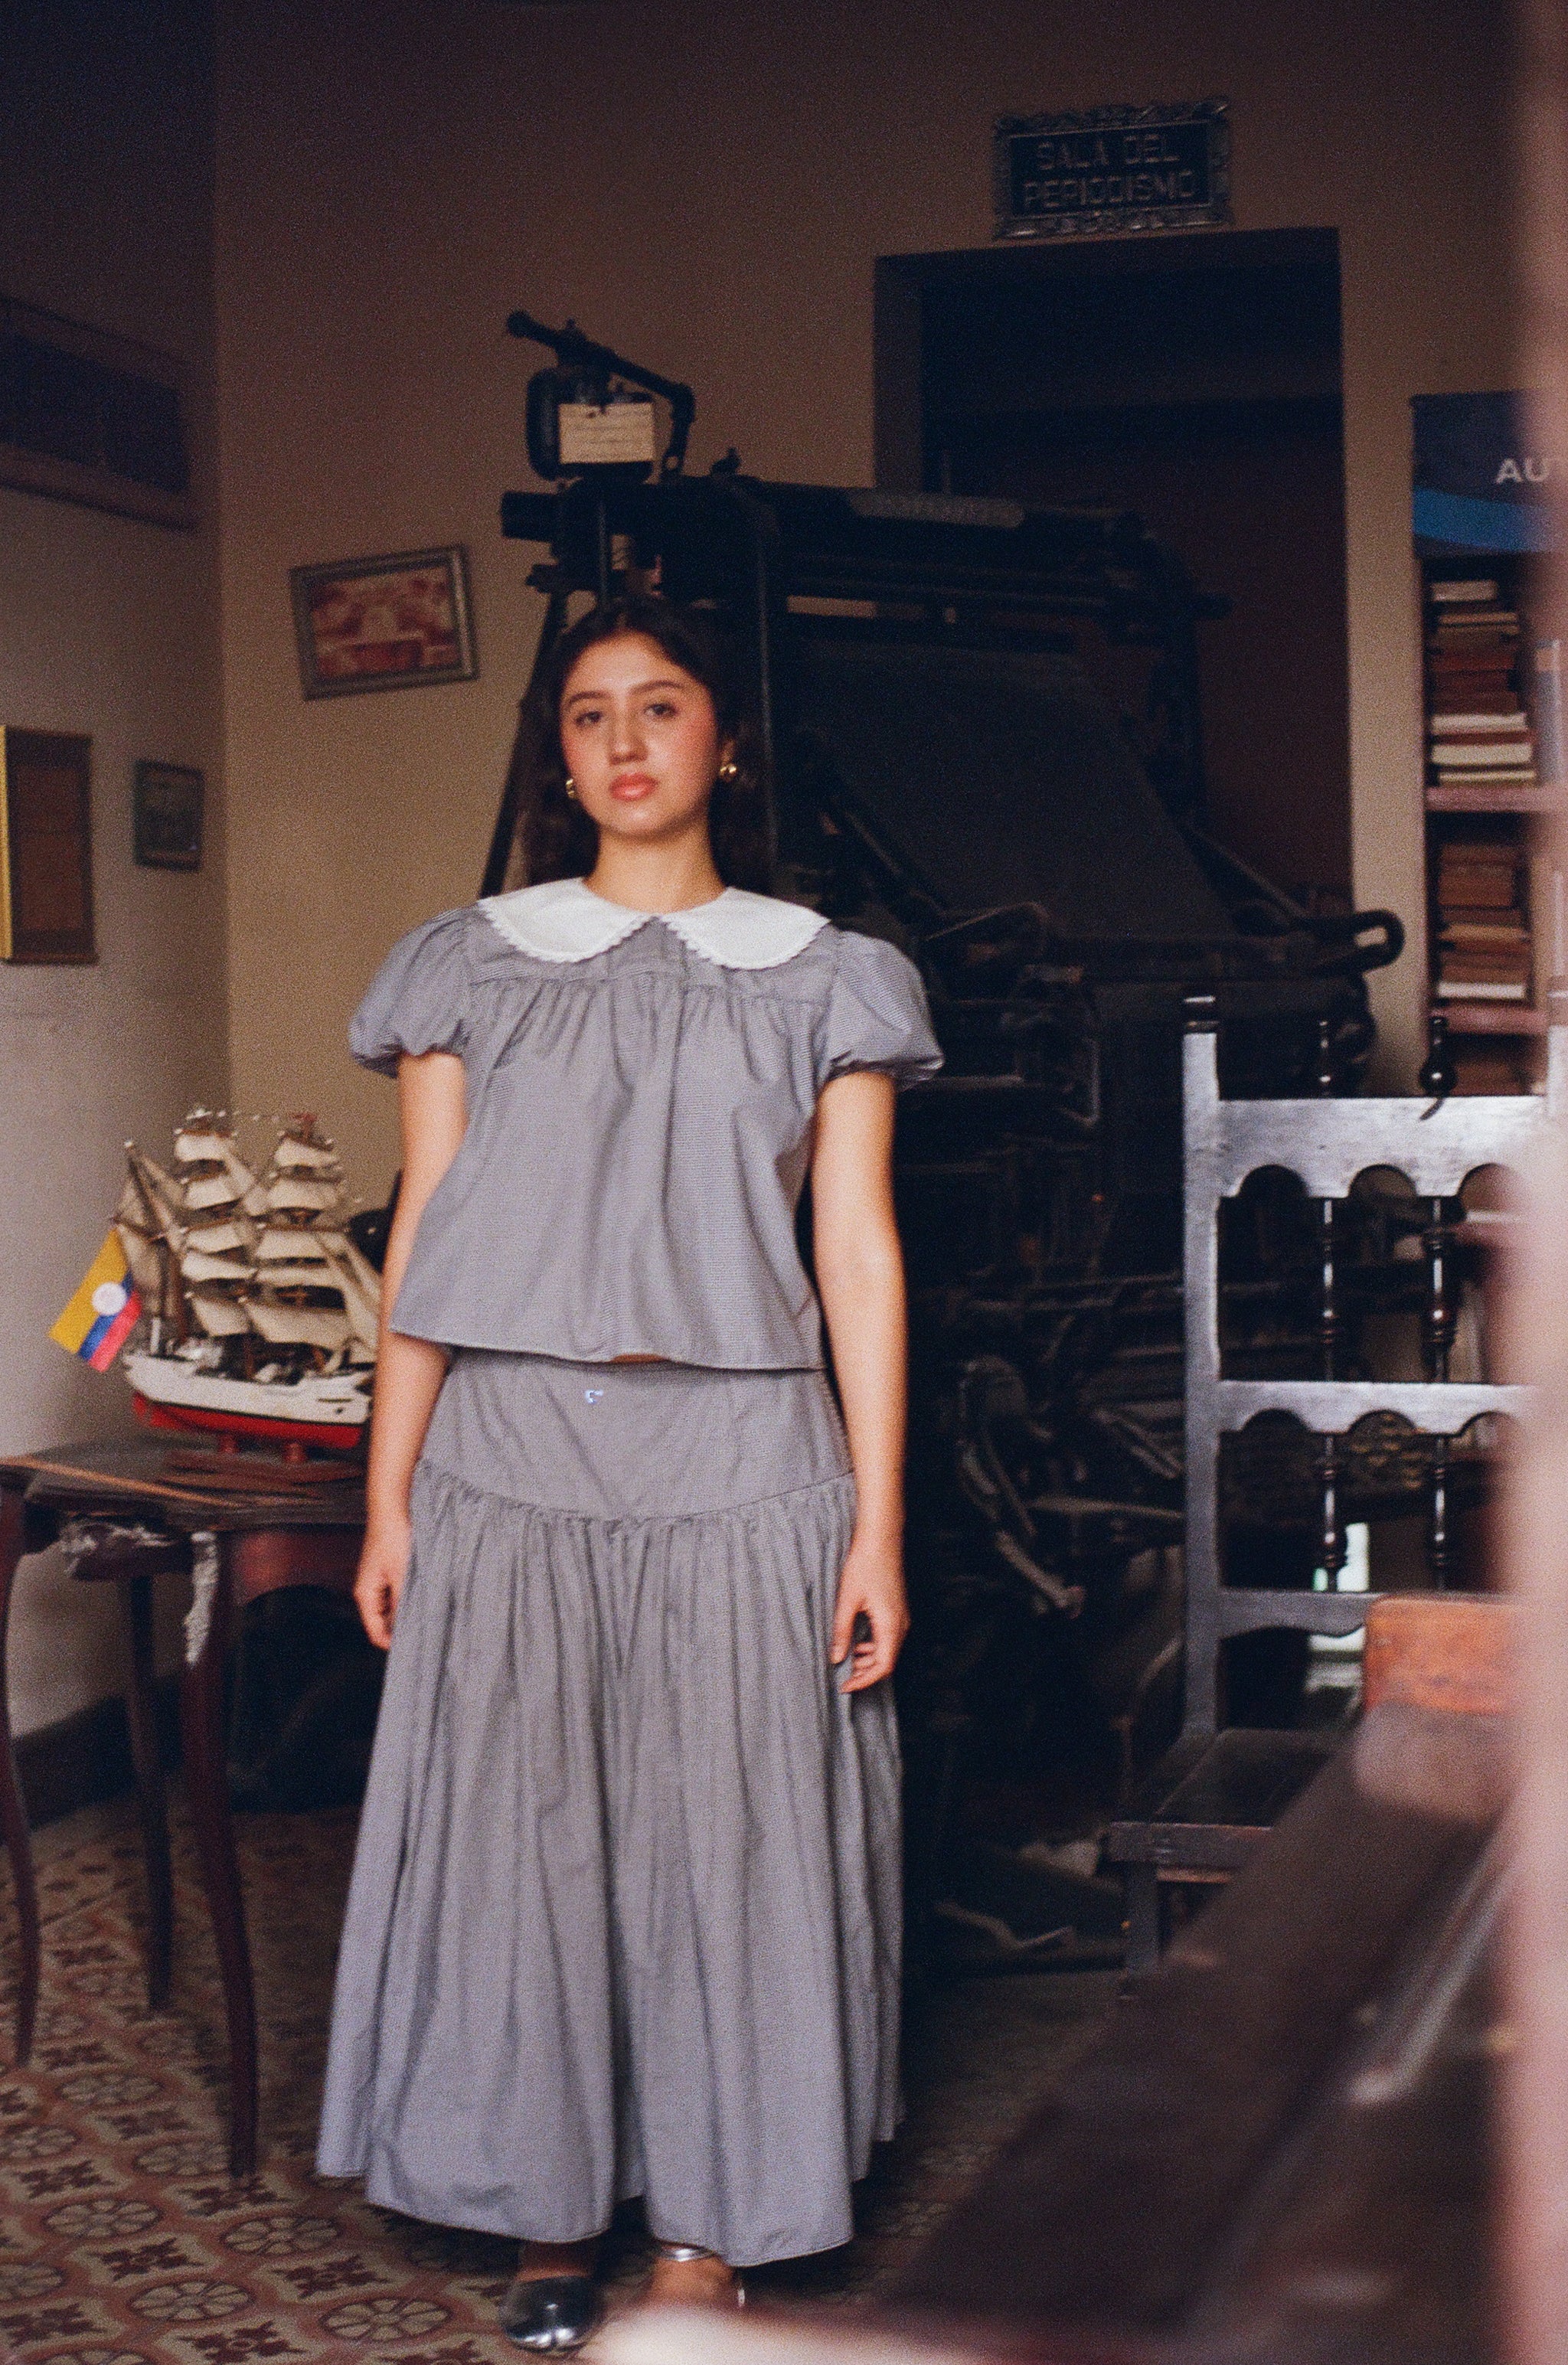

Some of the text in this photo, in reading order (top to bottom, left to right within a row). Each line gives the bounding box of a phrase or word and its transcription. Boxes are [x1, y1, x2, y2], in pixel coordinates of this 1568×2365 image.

[1036, 133, 1180, 171] SALA DEL
[1023, 169, 1194, 210] PERIODISMO
[1494, 458, 1551, 484] AU
